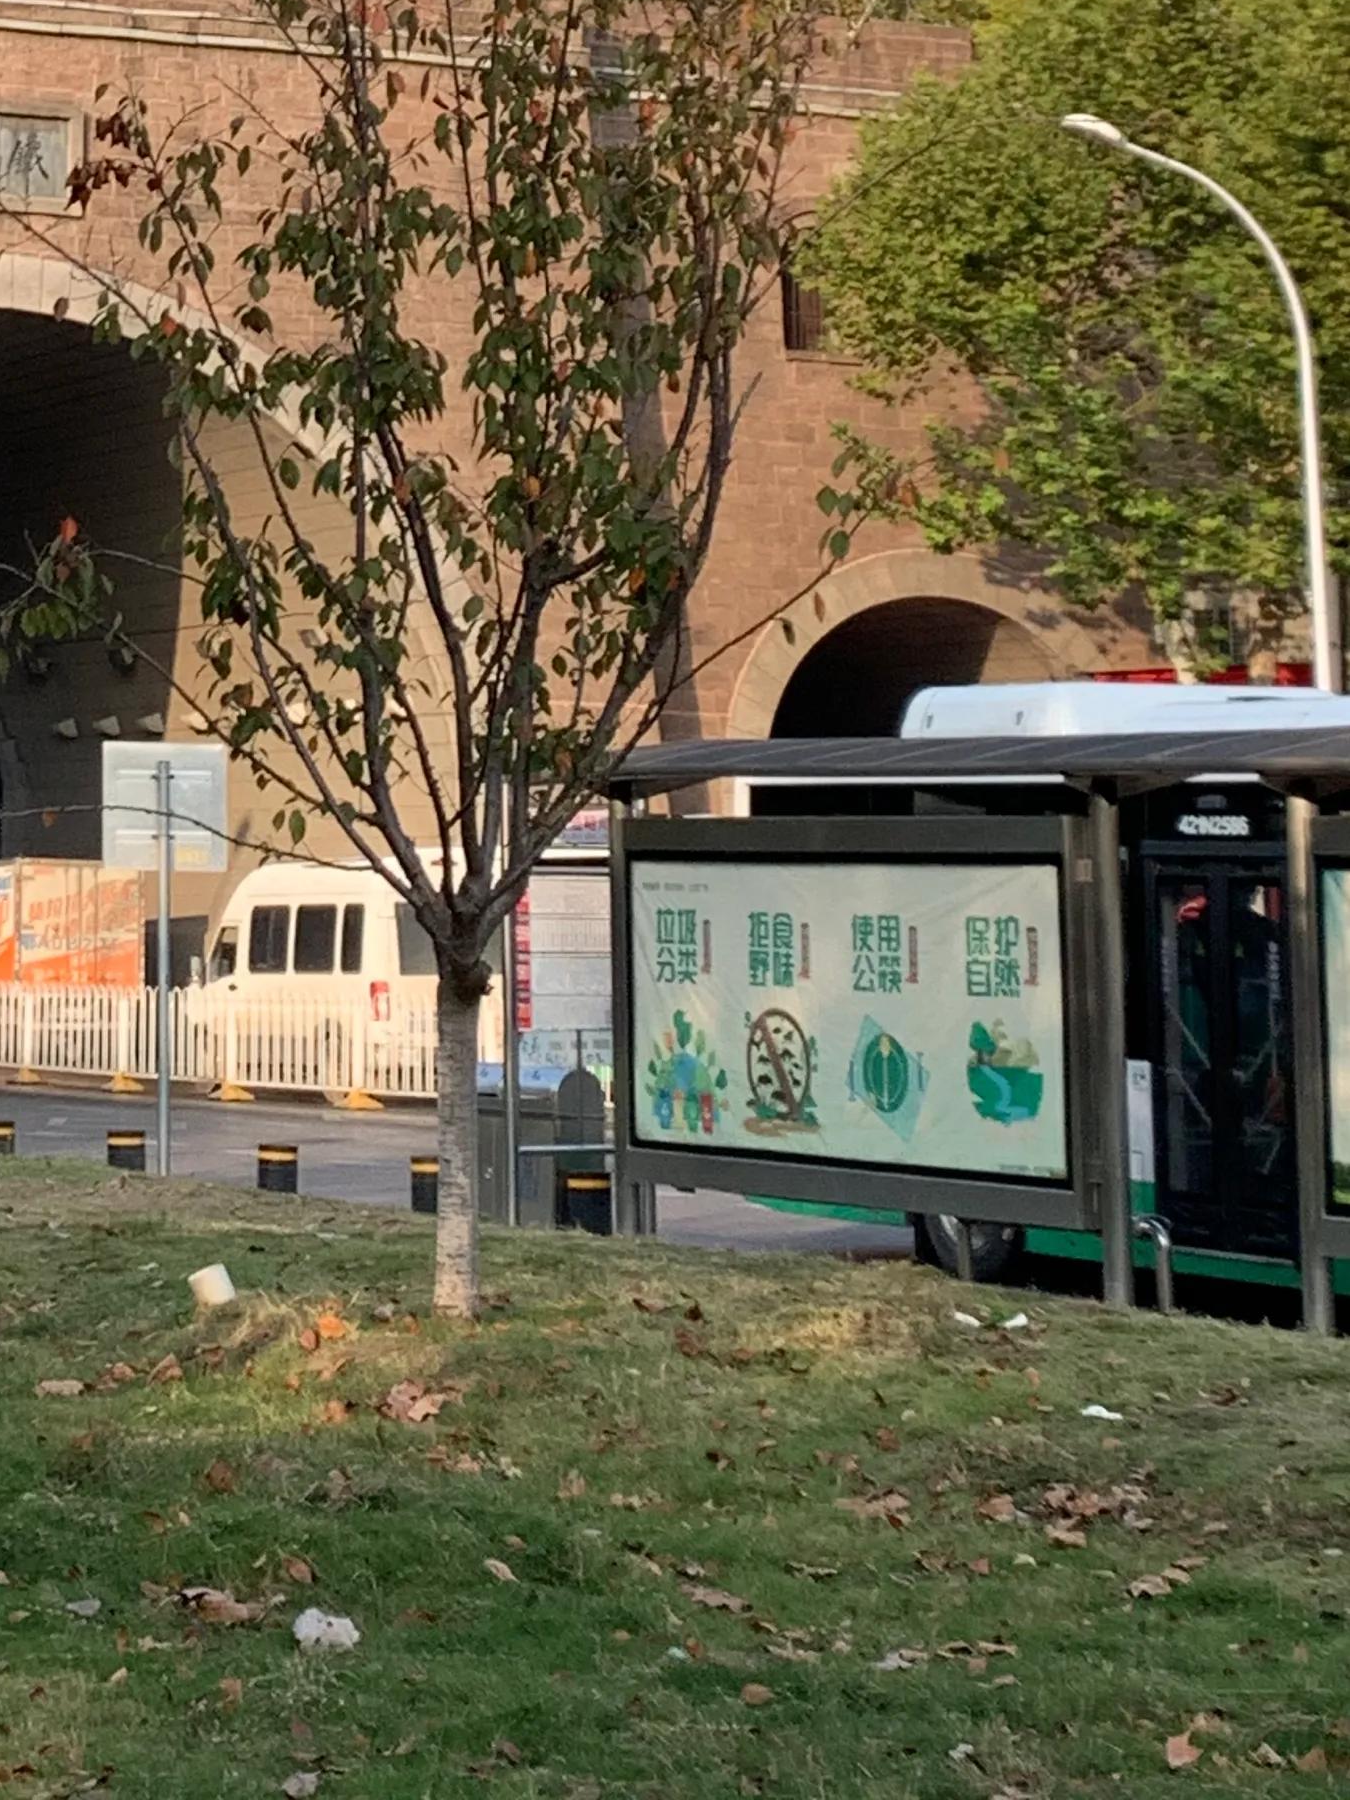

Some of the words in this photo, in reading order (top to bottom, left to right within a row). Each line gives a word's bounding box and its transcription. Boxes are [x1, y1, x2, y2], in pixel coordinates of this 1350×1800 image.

[656, 907, 698, 945] 垃圾
[748, 911, 794, 950] 拒食
[851, 914, 901, 953] 使用
[966, 916, 1020, 957] 保护
[656, 946, 698, 985] 分类
[748, 951, 795, 987] 野味
[852, 954, 903, 993] 公筷
[966, 958, 1021, 998] 自然
